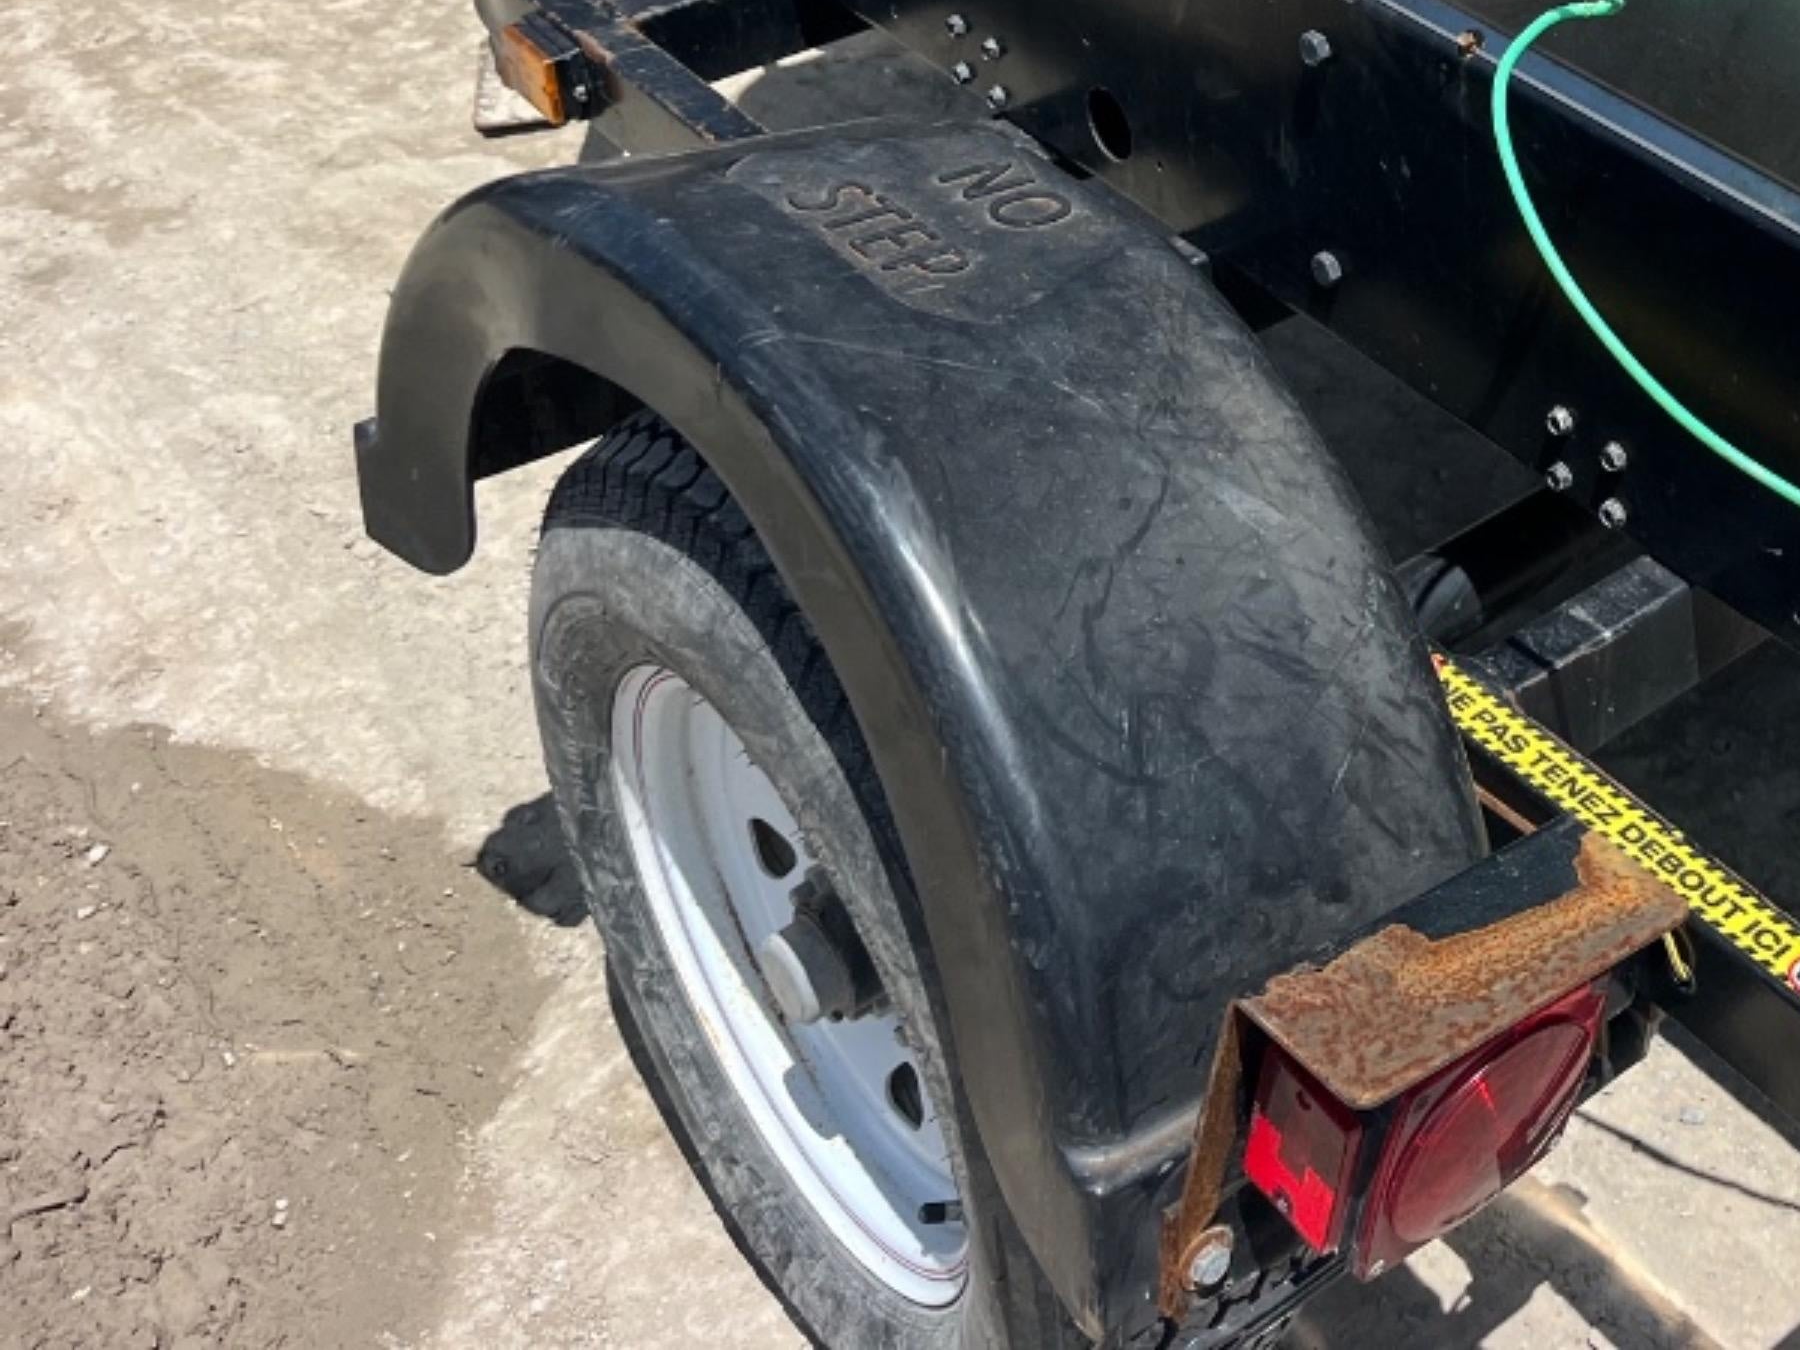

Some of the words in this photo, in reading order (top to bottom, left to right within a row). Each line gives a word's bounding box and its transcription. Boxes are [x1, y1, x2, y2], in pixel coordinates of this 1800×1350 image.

[784, 184, 971, 274] STEP
[937, 161, 1072, 227] NO
[1469, 708, 1530, 753] PAS
[1529, 751, 1623, 826] TENEZ
[1618, 823, 1748, 920] DEBOUT
[1743, 920, 1792, 960] ICI
